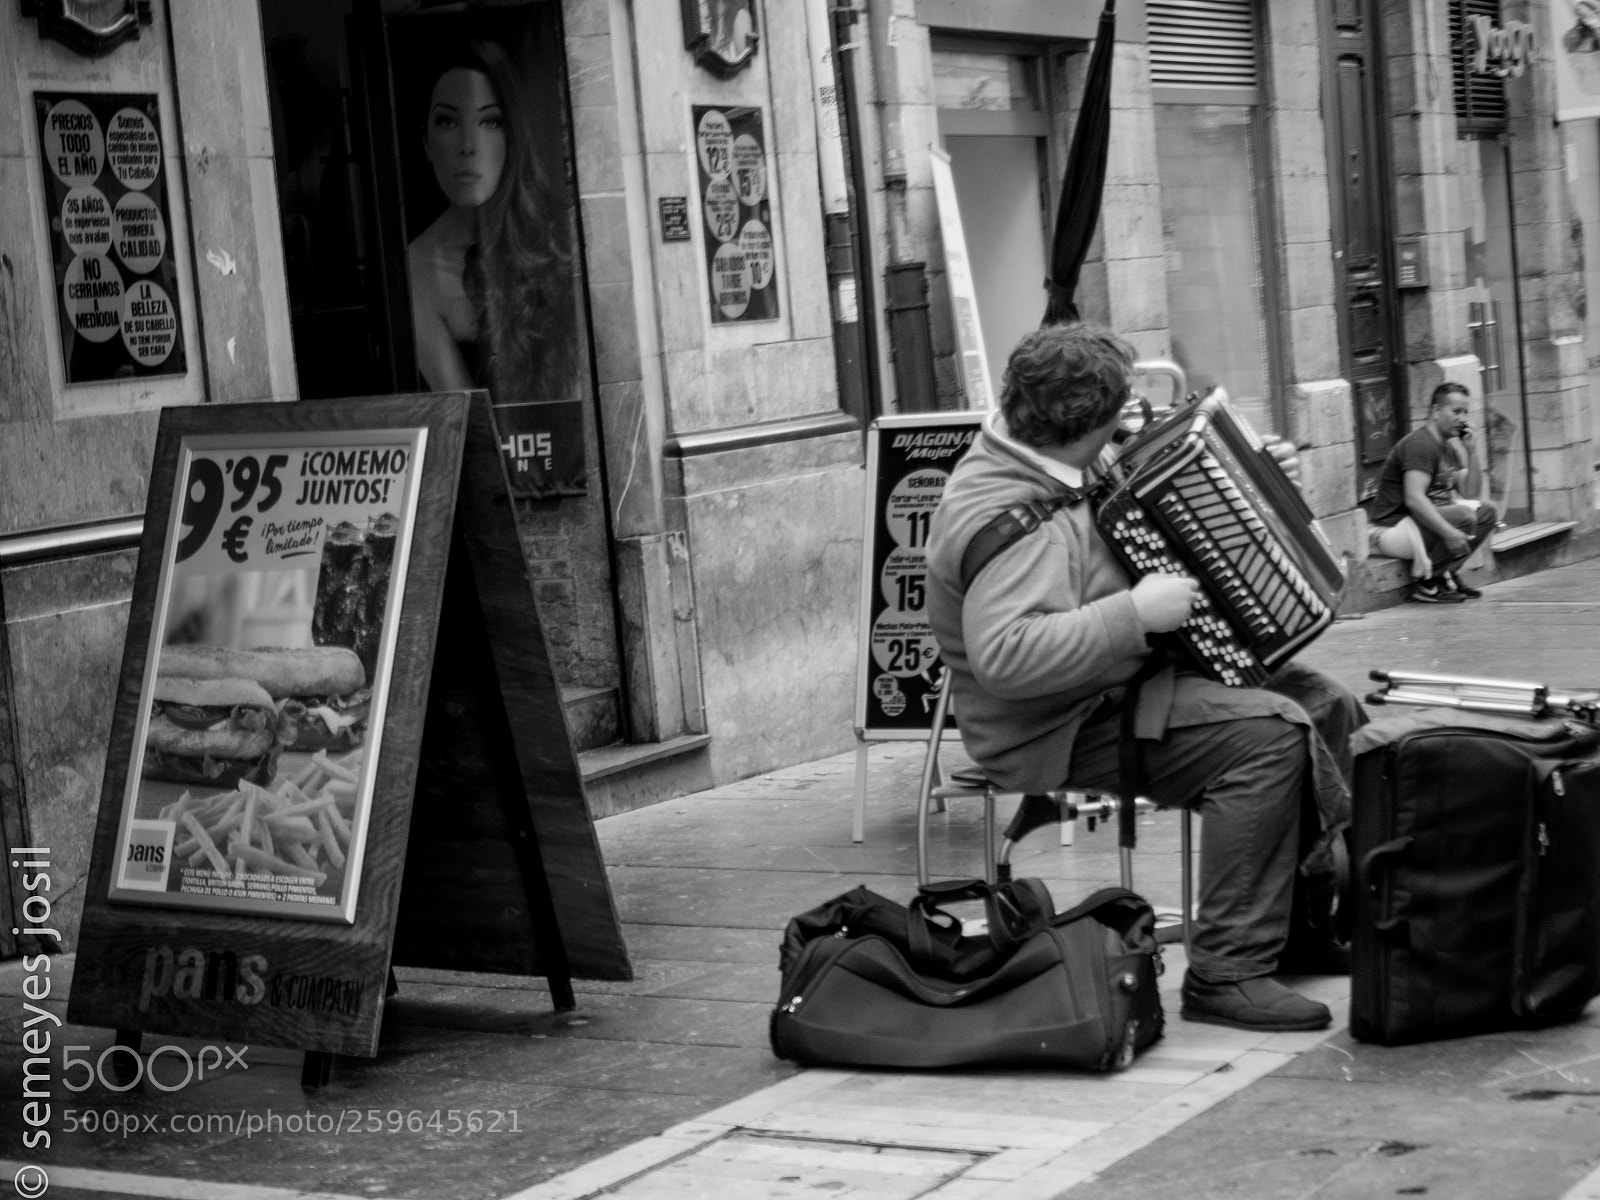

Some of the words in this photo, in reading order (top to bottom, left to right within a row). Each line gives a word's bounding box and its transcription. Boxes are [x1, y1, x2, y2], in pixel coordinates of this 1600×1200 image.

[51, 113, 94, 131] PRECIOS
[117, 115, 144, 129] Somos
[59, 133, 91, 153] TODO
[58, 157, 71, 176] EL
[74, 153, 97, 176] AÑO
[67, 199, 79, 213] 35
[82, 195, 105, 213] AÑOS
[115, 207, 159, 221] PRODUCTOS
[122, 223, 155, 237] PRIMERA
[120, 240, 161, 258] CALIDAD
[83, 258, 102, 280] NO
[68, 281, 120, 299] CERRAMOS
[140, 283, 152, 299] LA
[131, 300, 168, 317] BELLEZA
[124, 320, 134, 333] DE
[135, 319, 145, 332] SU
[146, 318, 174, 331] CABELLO
[891, 430, 981, 452] DIAGONA
[905, 445, 960, 461] Mujer
[299, 449, 409, 477] ¡COMEMO
[908, 475, 947, 489] SEÑORAS
[221, 515, 254, 563] €
[895, 574, 926, 612] 15
[888, 638, 921, 671] 25
[921, 646, 935, 659] €
[138, 945, 269, 1014] pans
[286, 975, 366, 1016] COMPANY
